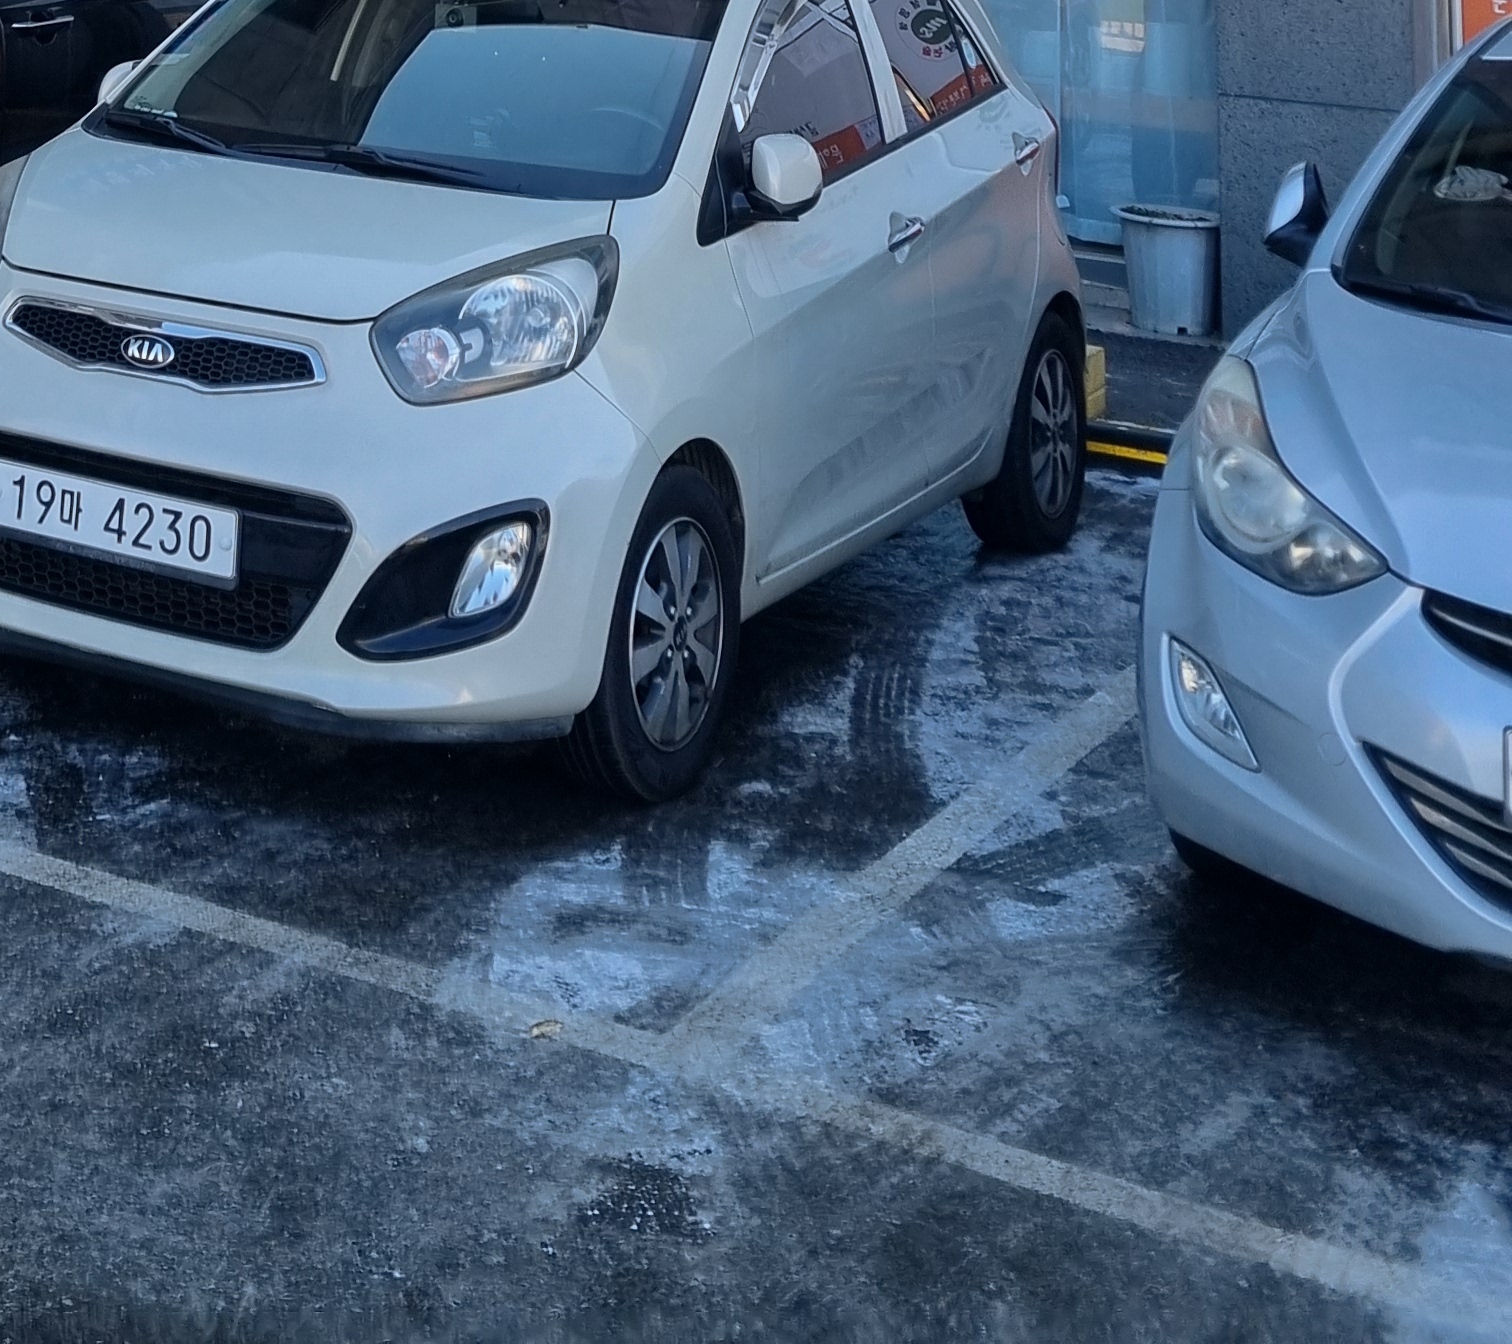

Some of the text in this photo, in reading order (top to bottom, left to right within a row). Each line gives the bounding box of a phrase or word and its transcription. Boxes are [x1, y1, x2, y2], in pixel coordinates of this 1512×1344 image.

[127, 338, 164, 363] KIA
[12, 474, 212, 563] 19마 4230
